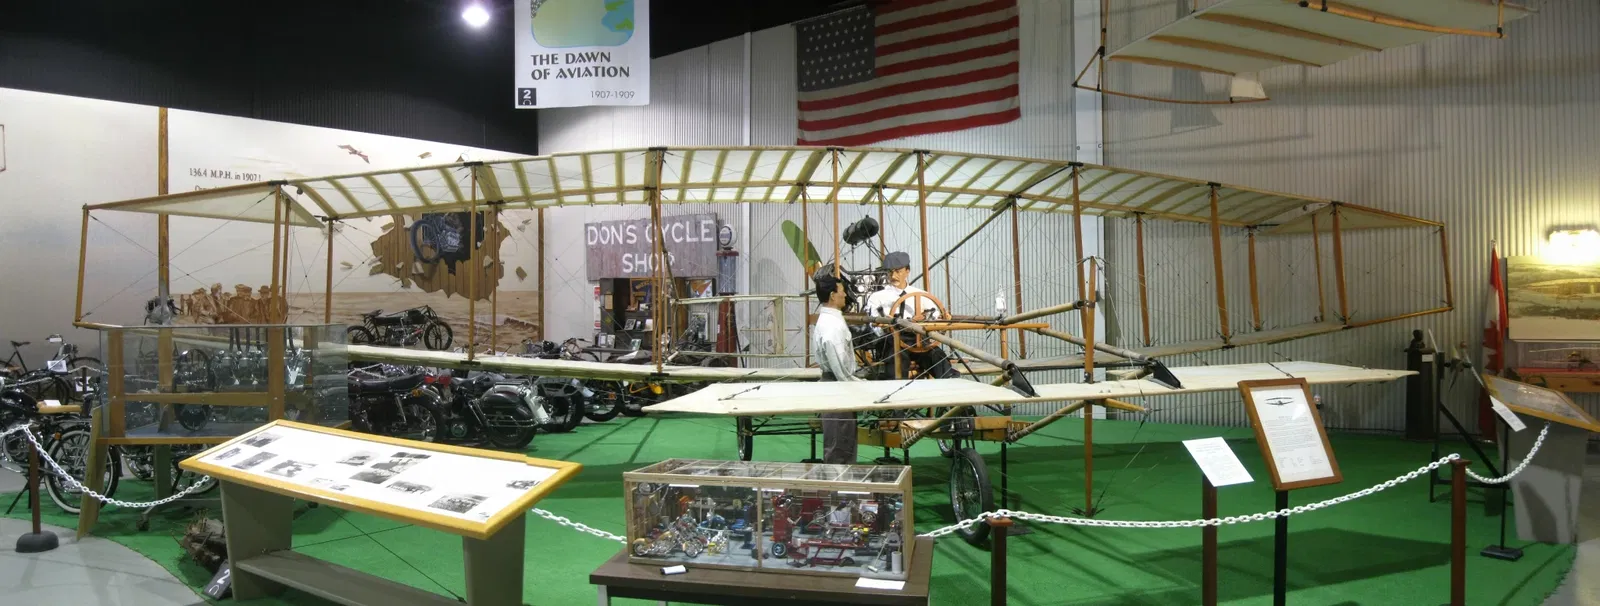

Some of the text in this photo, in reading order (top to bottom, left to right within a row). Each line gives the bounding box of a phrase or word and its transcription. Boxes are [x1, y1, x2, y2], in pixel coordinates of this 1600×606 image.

[531, 52, 611, 66] THE DAWN
[531, 66, 630, 81] OF AVIATION
[523, 89, 532, 99] 2
[590, 90, 635, 99] 1907-1909
[189, 168, 207, 178] 136.4
[210, 169, 233, 180] M.P.H.
[235, 172, 241, 180] in
[587, 220, 714, 246] DON'S CYCLE
[217, 569, 231, 584] 2
